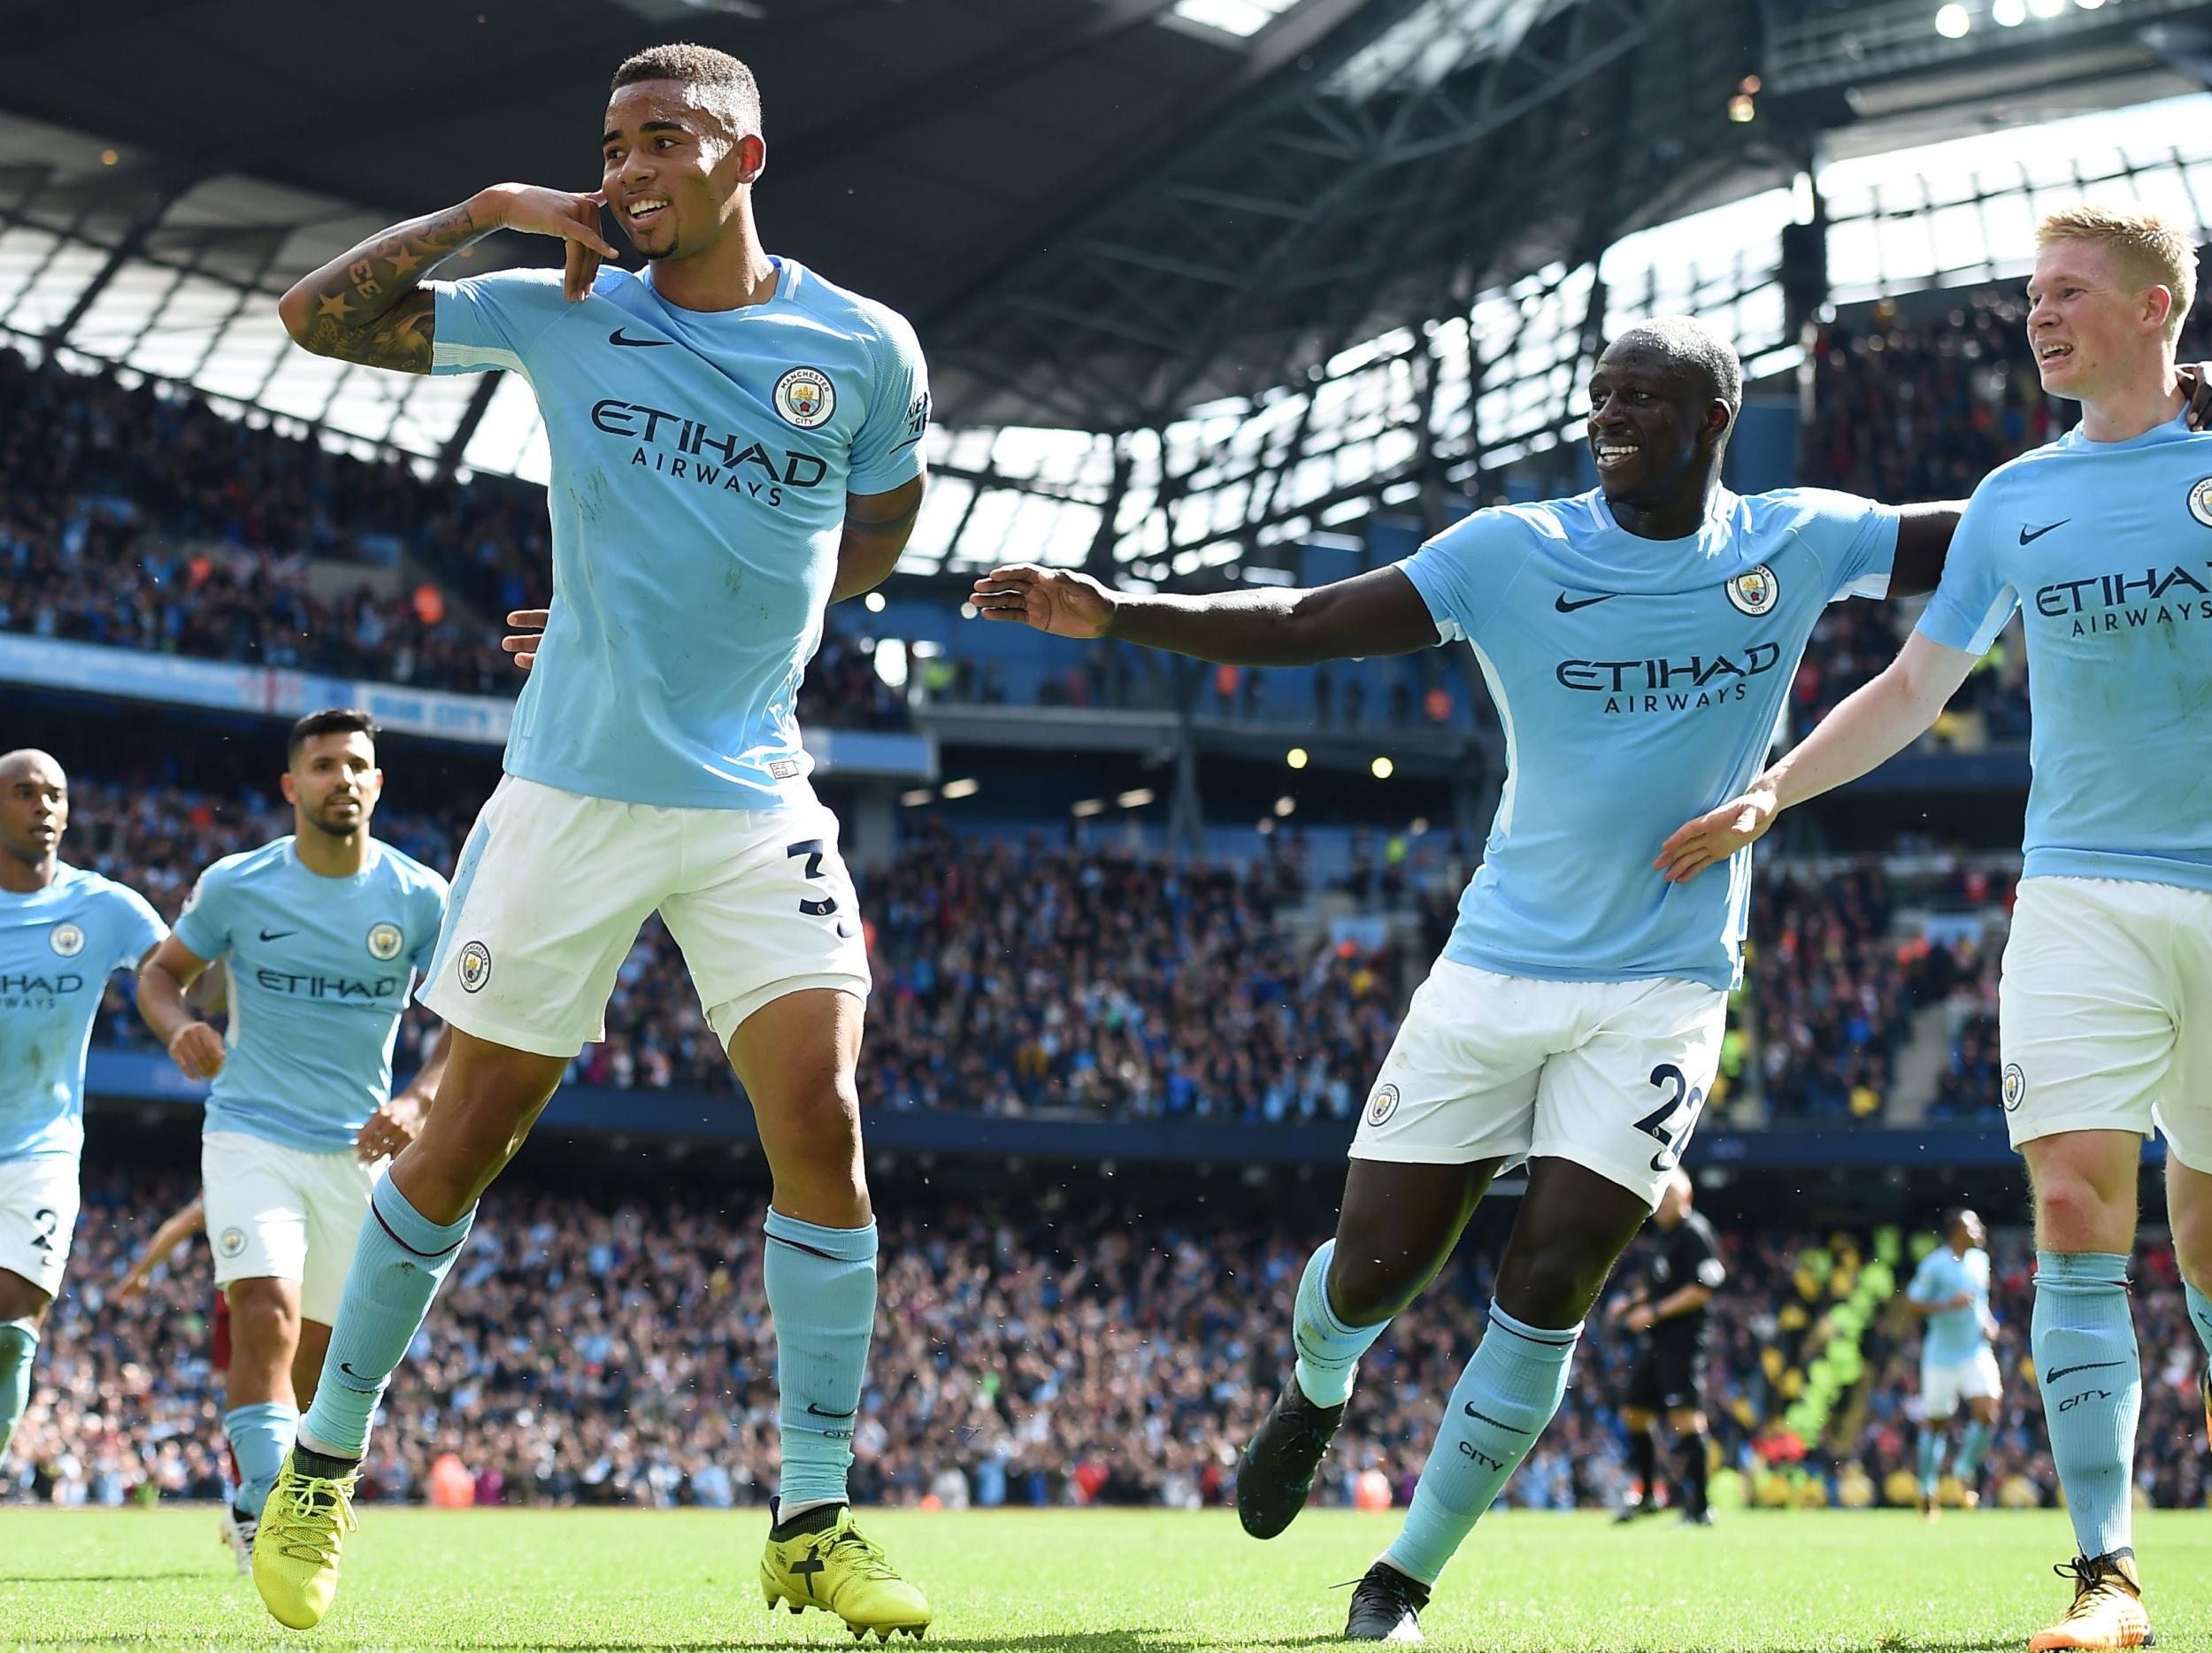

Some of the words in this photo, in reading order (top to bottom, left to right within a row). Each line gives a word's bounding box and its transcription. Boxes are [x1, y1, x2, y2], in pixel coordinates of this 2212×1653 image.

[780, 371, 830, 393] MANCHESTER
[591, 399, 828, 488] ETIHAD
[632, 447, 783, 507] AIRWAYS
[2036, 561, 2212, 618] ETIHA
[2071, 600, 2212, 638] AIRWAYS
[1555, 642, 1780, 692] ETIHAD
[1603, 683, 1747, 713] AIRWAYS
[257, 971, 397, 998] ETIHAD
[0, 997, 55, 1010] WAYS
[2059, 1390, 2113, 1412] CITY
[1458, 1441, 1504, 1472] CITY
